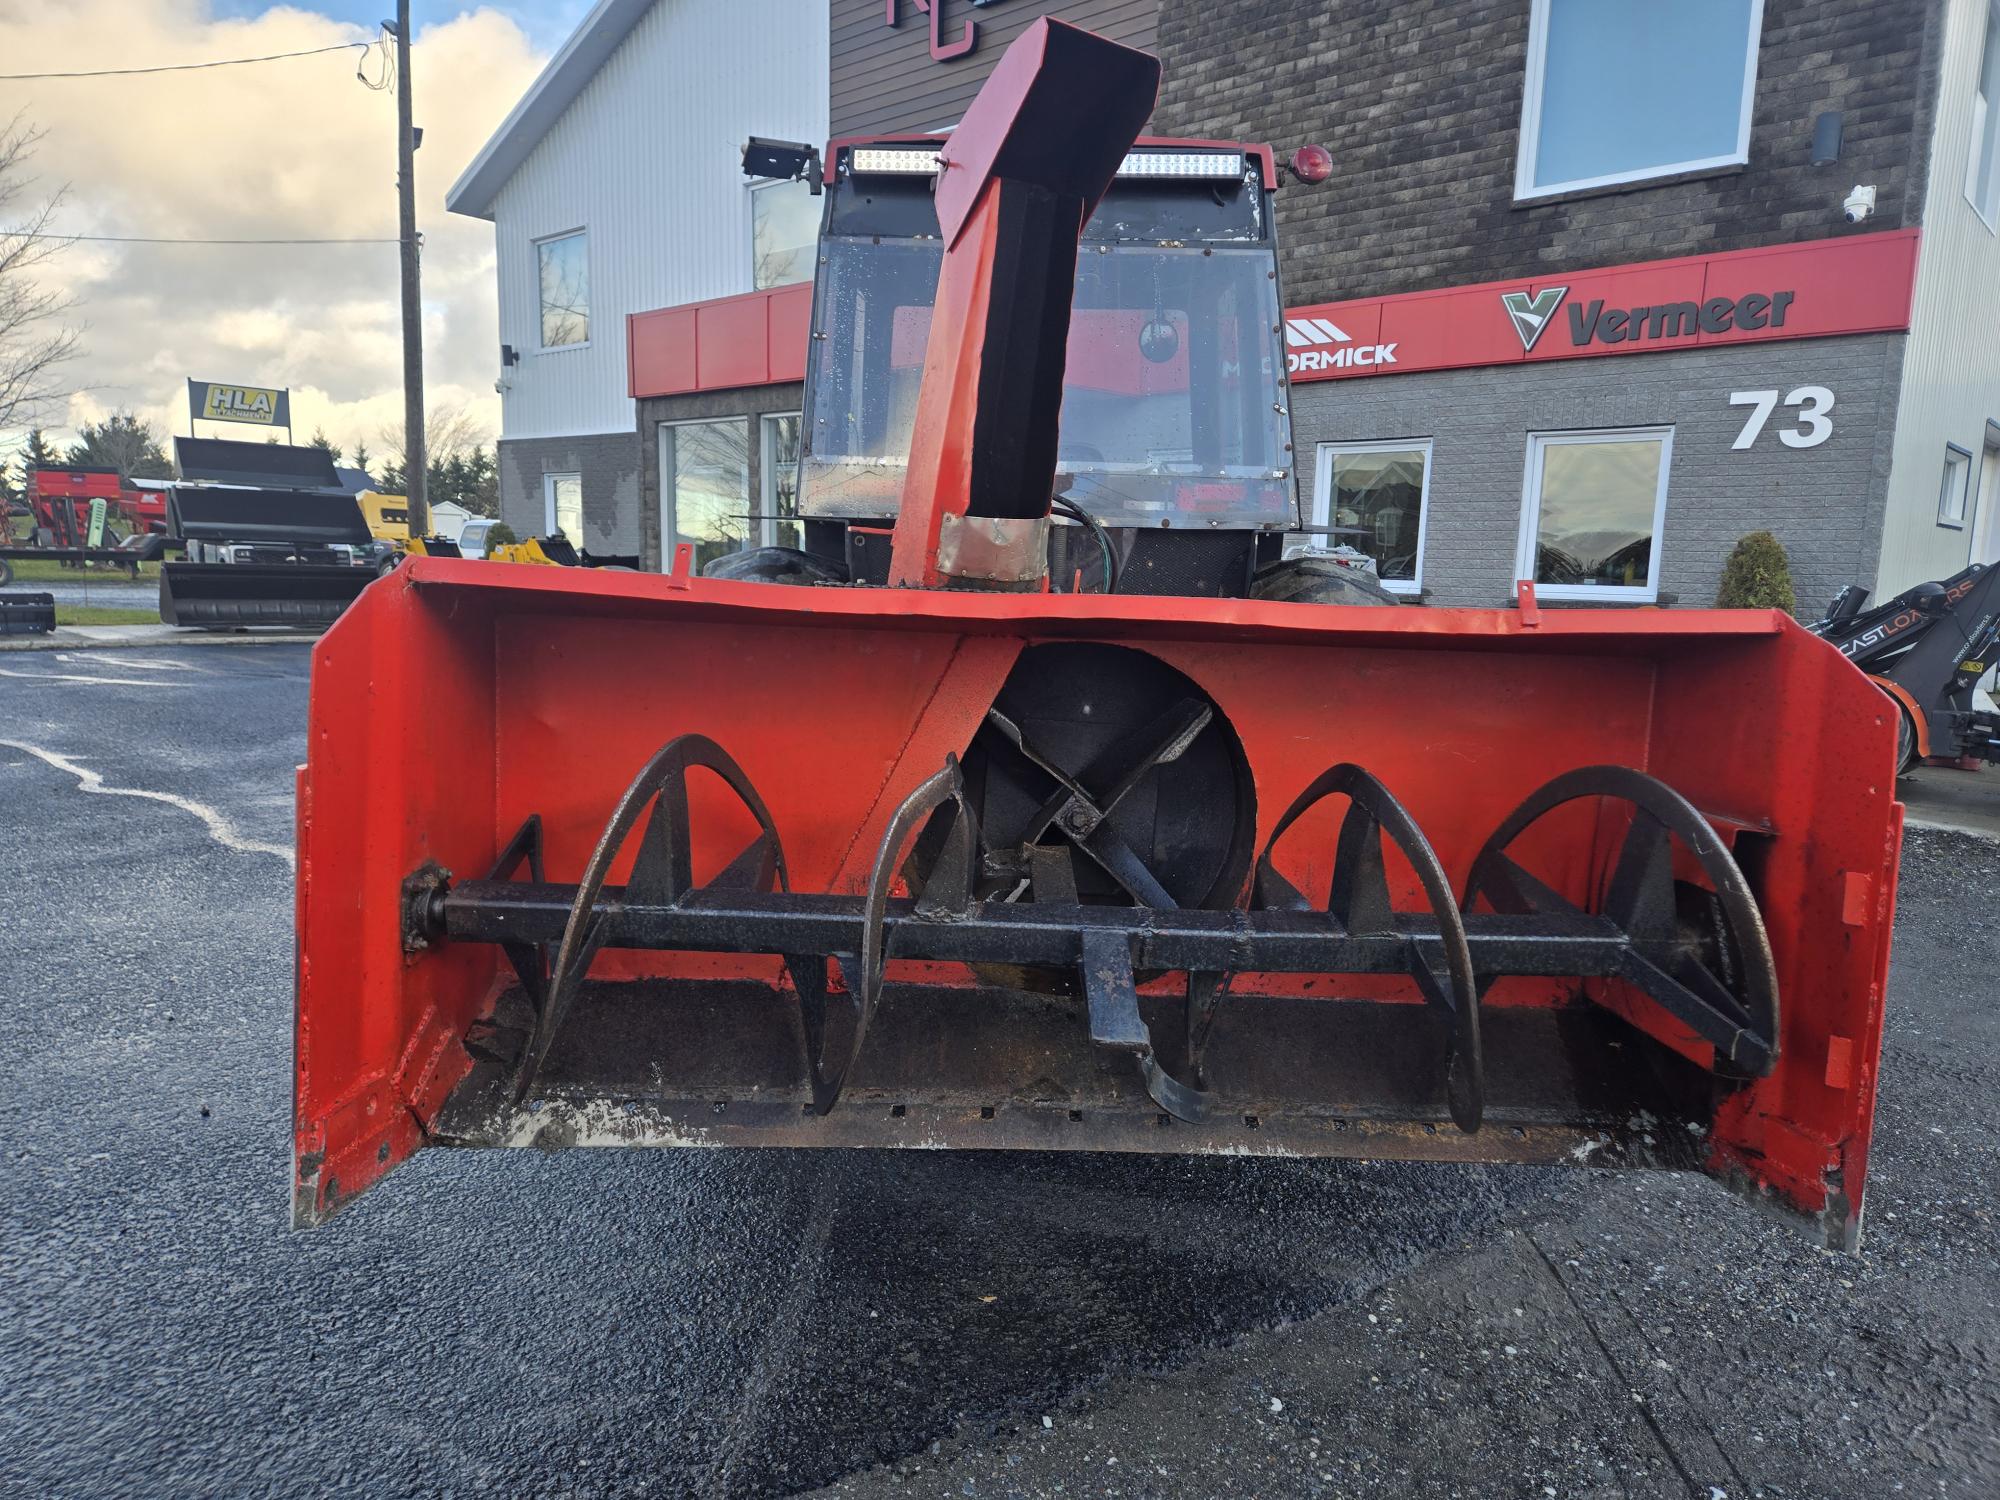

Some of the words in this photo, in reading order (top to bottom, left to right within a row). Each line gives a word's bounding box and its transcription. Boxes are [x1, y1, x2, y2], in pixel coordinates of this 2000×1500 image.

[1567, 290, 1795, 346] Vermeer
[211, 387, 272, 414] HLA
[1729, 386, 1835, 450] 73
[1838, 580, 1974, 657] CASTLOARS
